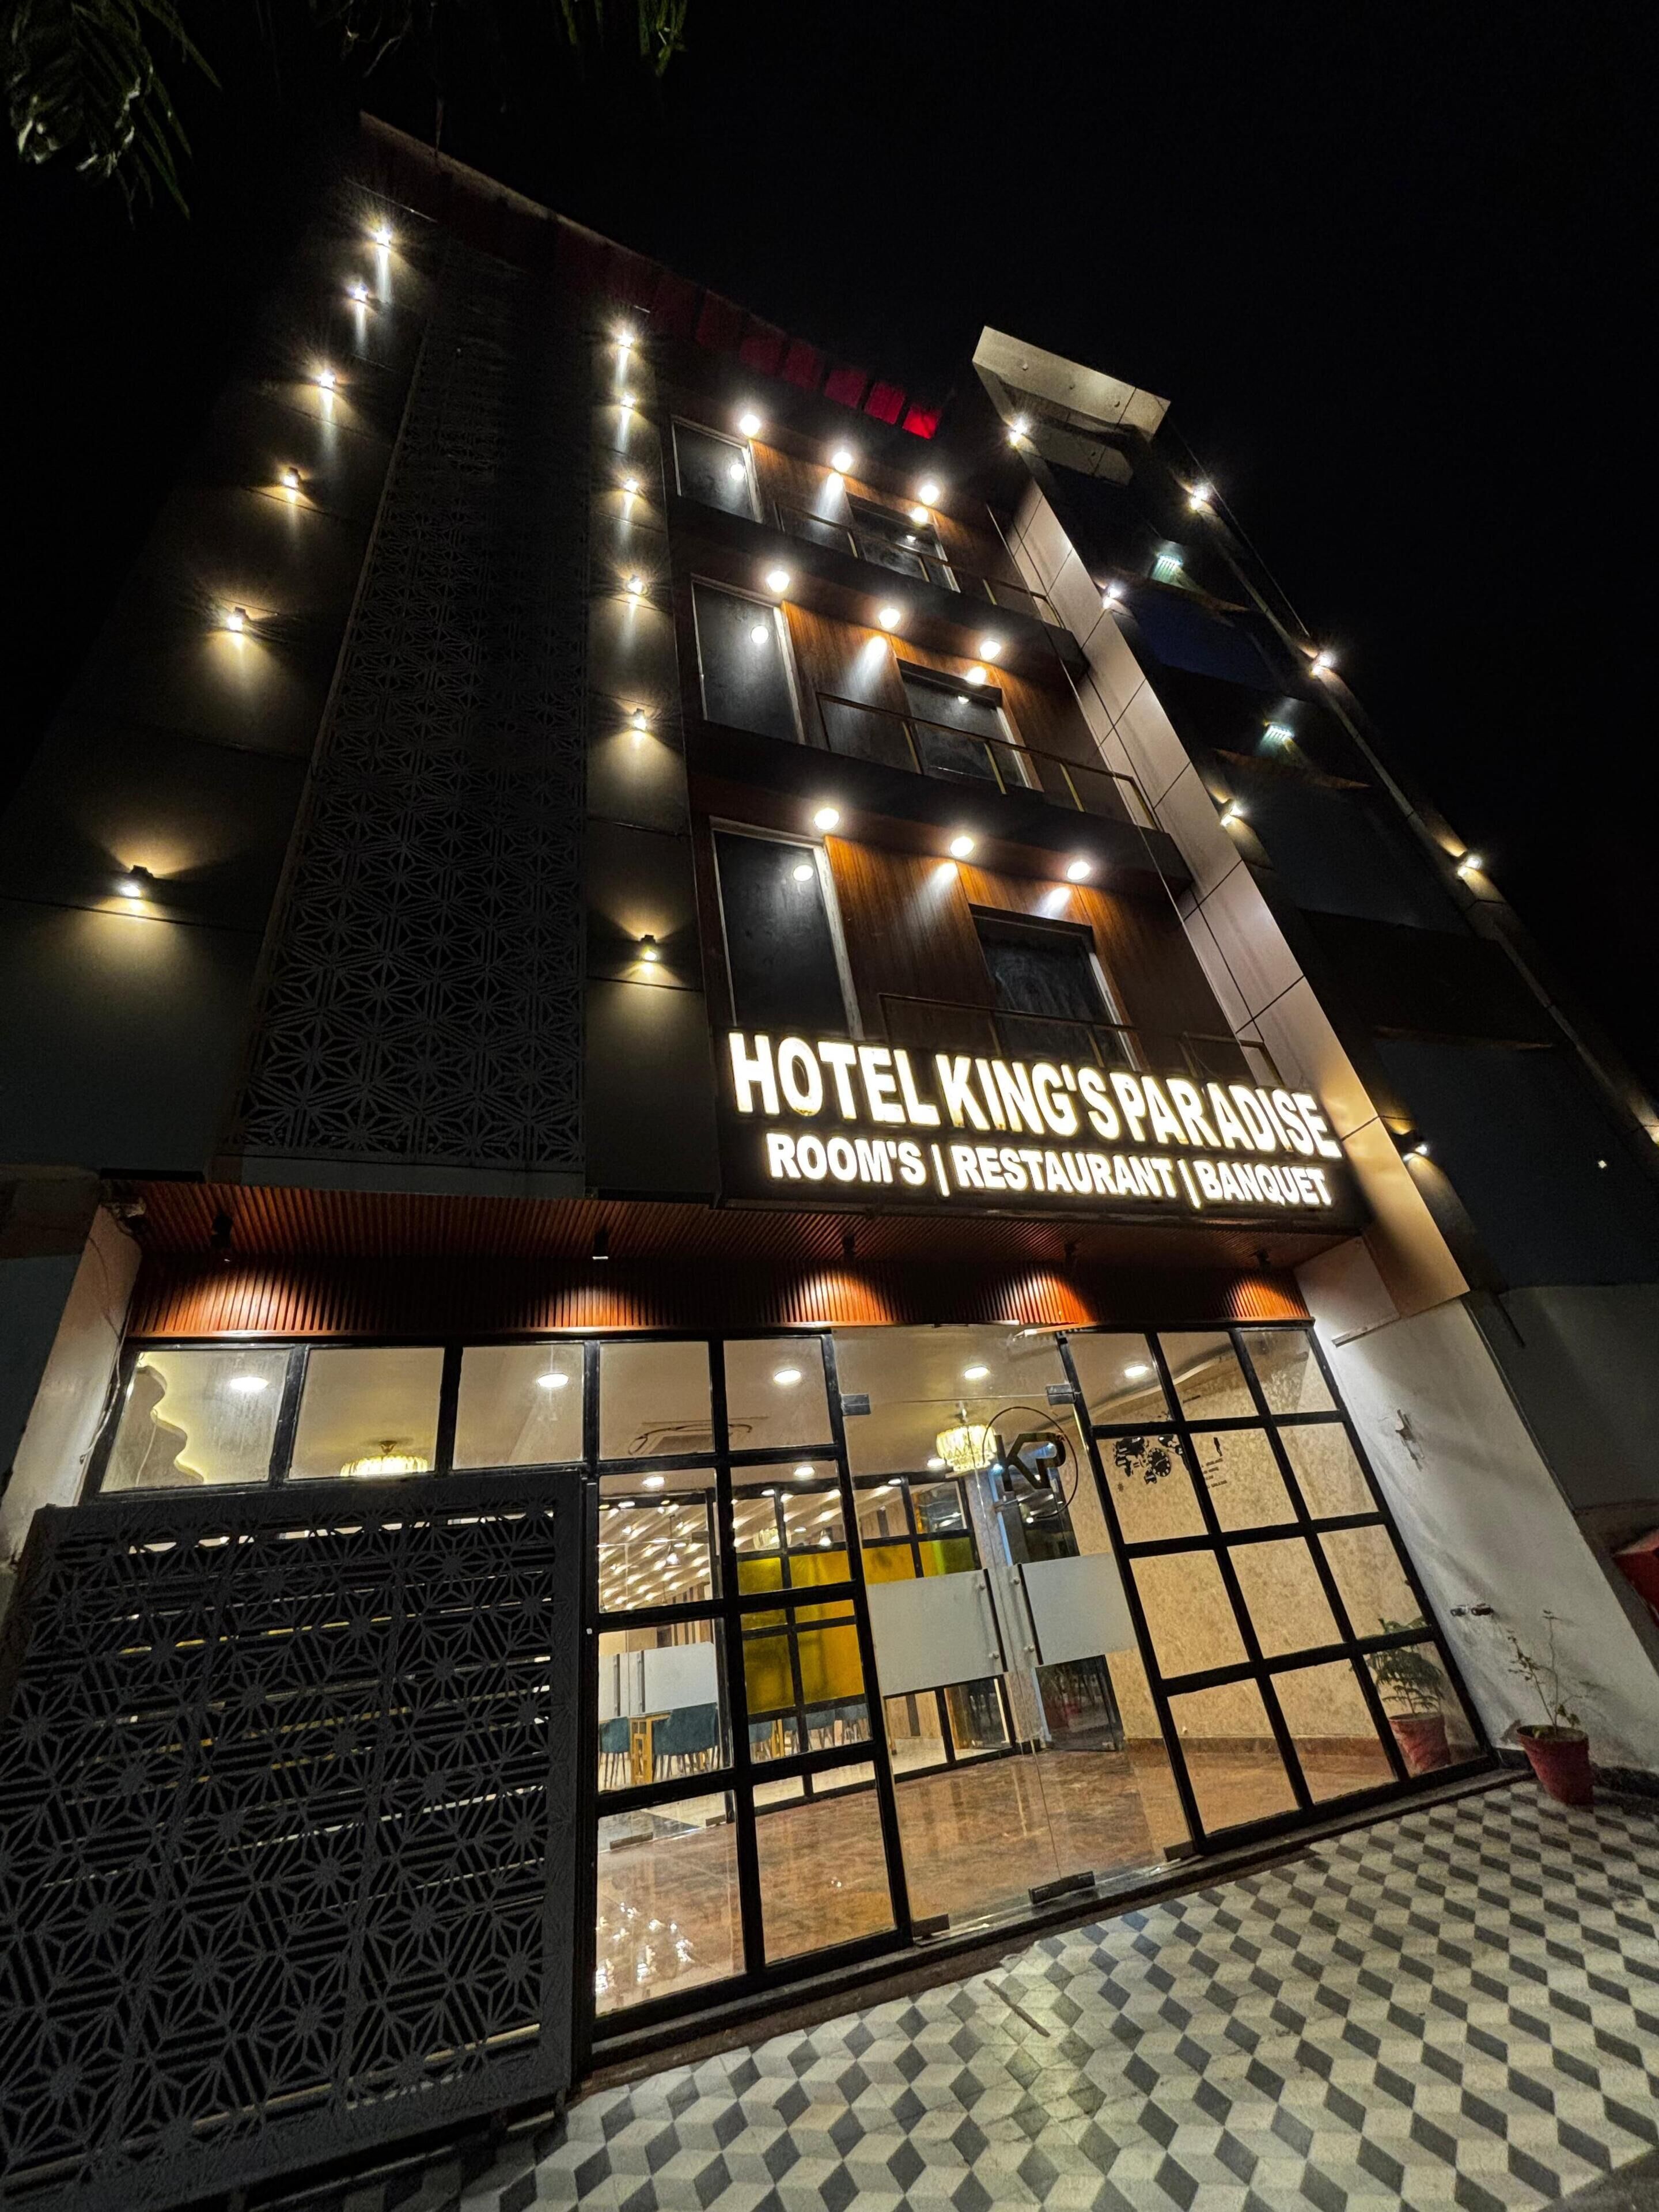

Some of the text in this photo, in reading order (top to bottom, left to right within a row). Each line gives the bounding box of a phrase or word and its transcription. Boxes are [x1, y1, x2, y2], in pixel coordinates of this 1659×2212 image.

[728, 1032, 1343, 1158] HOTEL KING'S PARADISE
[766, 1132, 926, 1185] ROOM'S
[950, 1145, 1176, 1198] RESTAURANT
[1193, 1160, 1332, 1206] BANQUET
